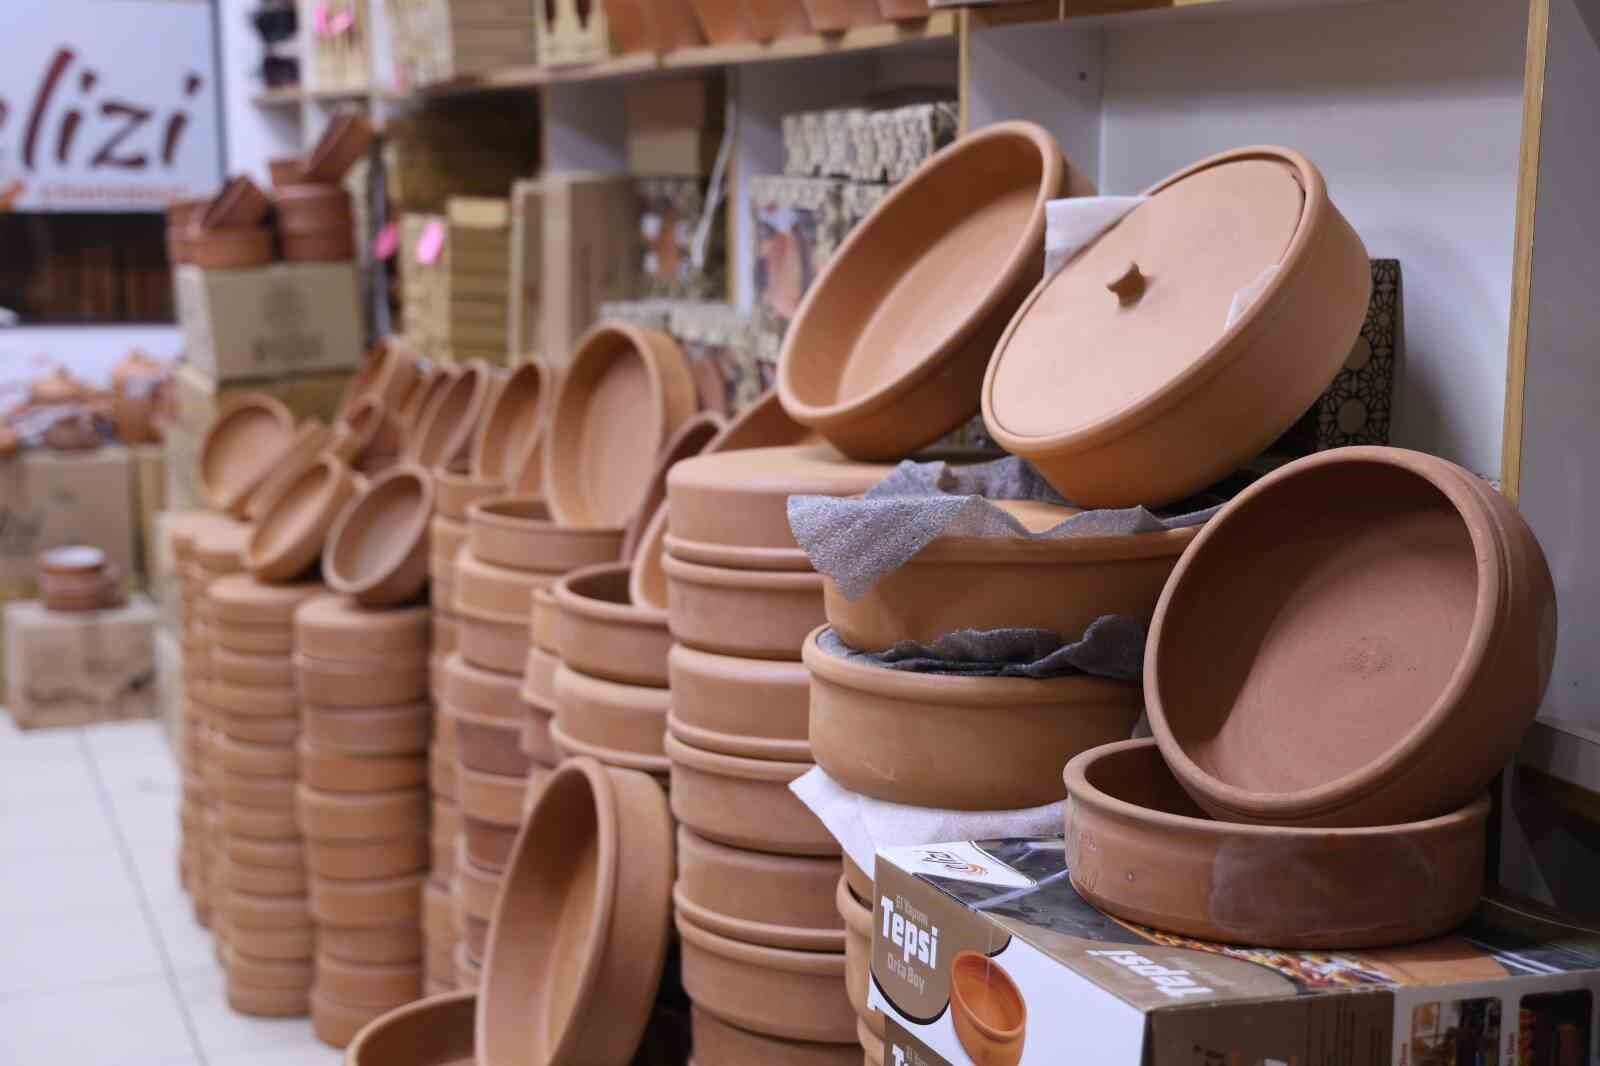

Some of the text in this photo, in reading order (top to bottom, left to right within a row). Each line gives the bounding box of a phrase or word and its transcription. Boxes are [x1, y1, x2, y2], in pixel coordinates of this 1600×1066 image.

[0, 48, 205, 172] lizi
[880, 895, 938, 969] Tepsi
[907, 966, 926, 994] Boy
